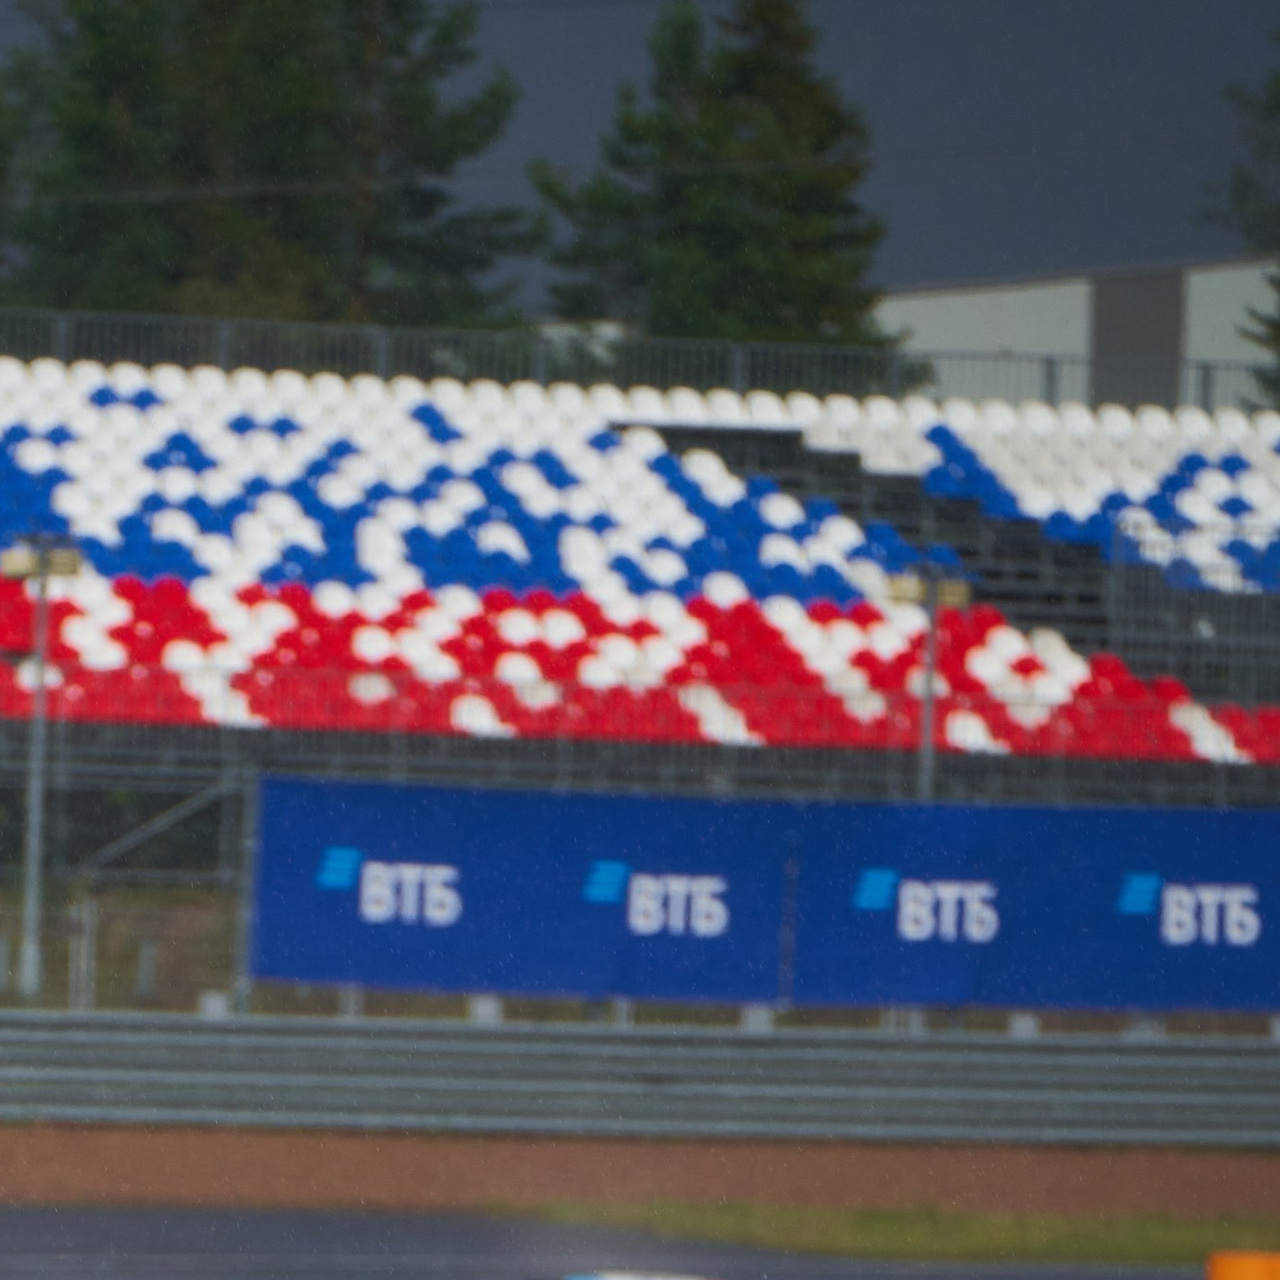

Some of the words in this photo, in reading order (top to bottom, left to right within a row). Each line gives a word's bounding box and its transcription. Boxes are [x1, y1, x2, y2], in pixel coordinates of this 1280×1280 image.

[360, 861, 461, 926] ВТБ
[628, 873, 729, 937] ВТБ
[897, 878, 999, 942] ВТБ
[1160, 883, 1260, 945] ВТБ
